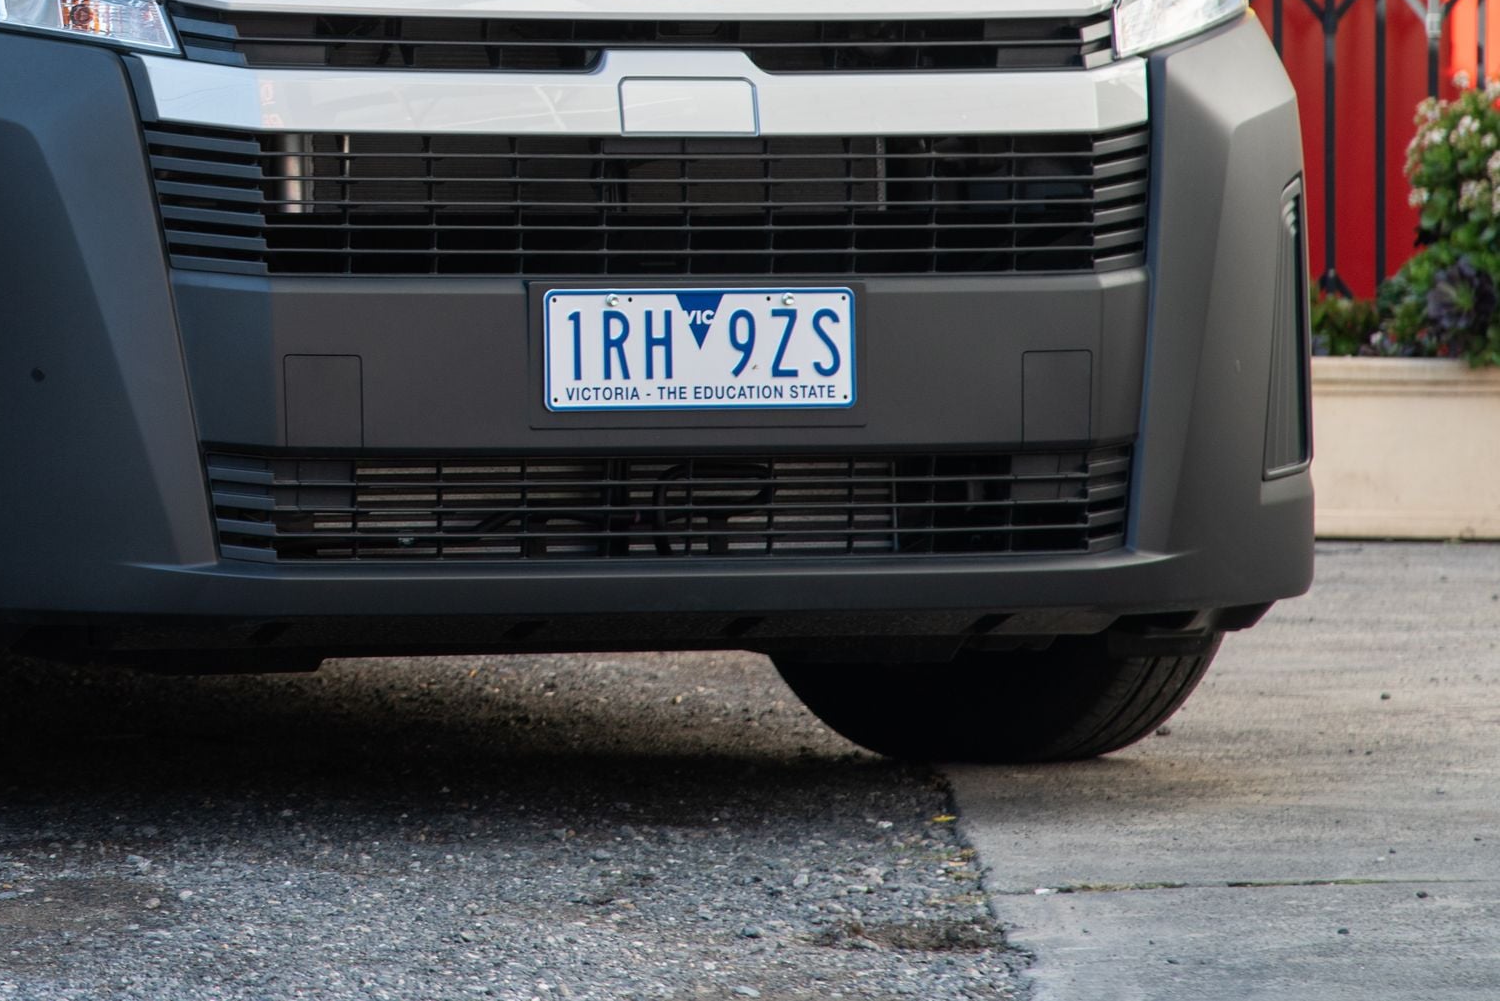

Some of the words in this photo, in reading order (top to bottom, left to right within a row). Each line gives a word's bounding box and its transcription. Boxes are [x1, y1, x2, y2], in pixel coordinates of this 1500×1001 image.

[683, 309, 715, 325] VIC
[566, 309, 674, 381] 1RH
[728, 308, 841, 378] 9ZS
[565, 386, 640, 401] VICTORIA
[657, 386, 688, 400] THE
[693, 385, 785, 400] EDUCATION
[789, 384, 836, 399] STATE
